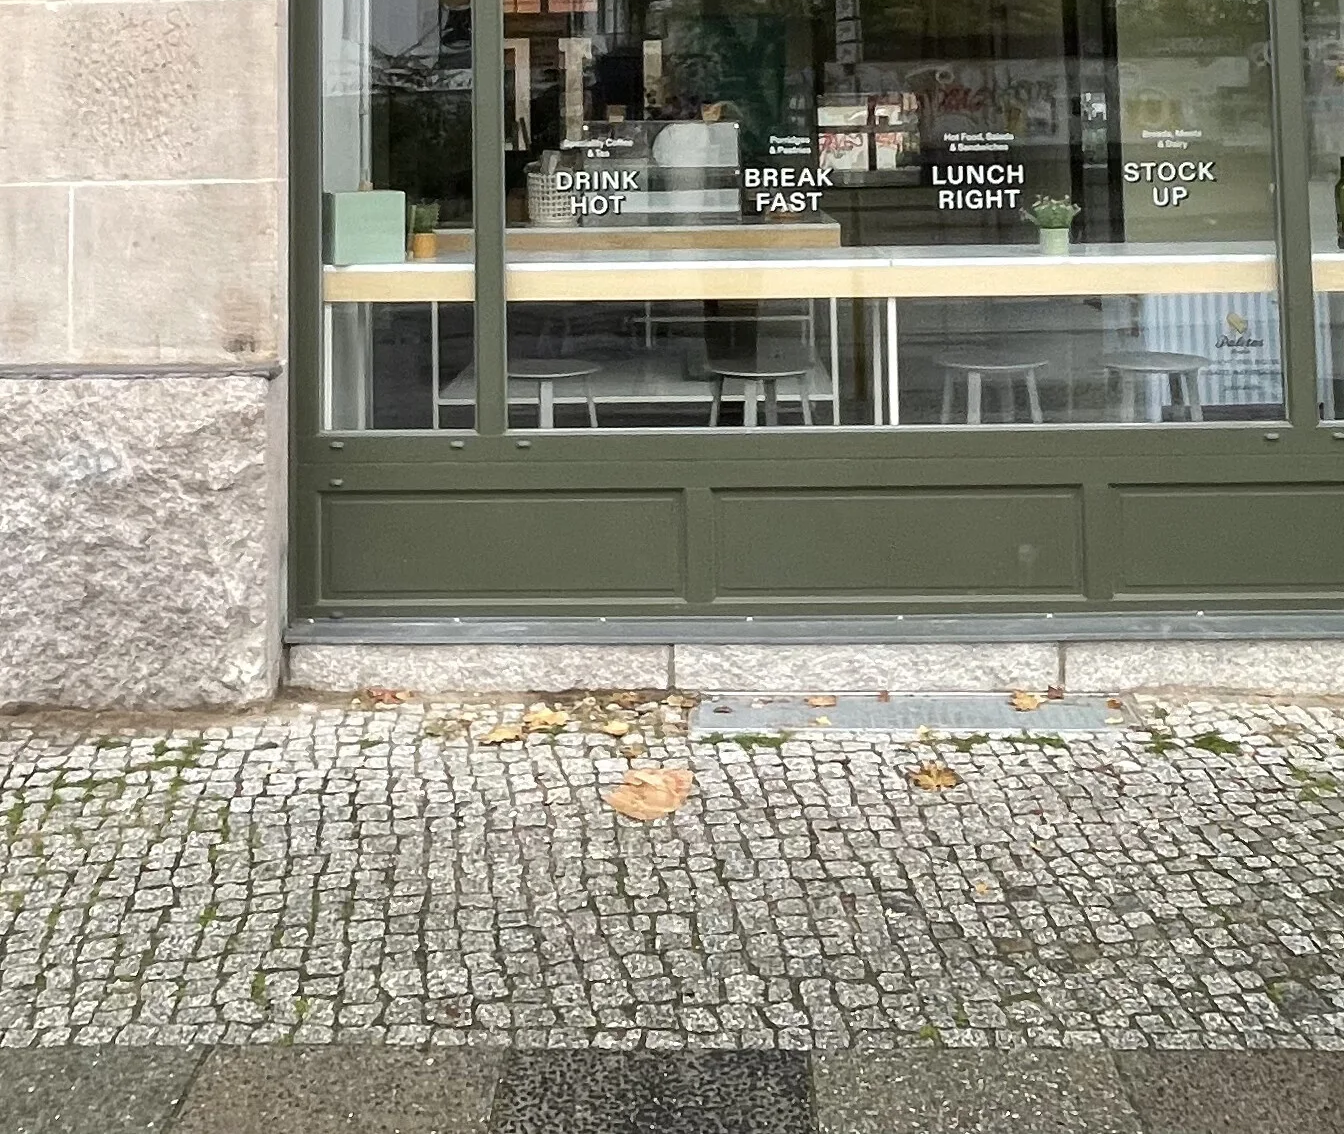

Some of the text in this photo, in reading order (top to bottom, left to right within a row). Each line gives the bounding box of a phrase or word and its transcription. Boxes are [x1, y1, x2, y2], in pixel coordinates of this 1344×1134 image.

[605, 137, 634, 148] Coffee
[556, 171, 639, 191] DRINK
[744, 168, 833, 187] BREAK
[932, 164, 1025, 185] LUNCH
[1123, 162, 1215, 182] STOCK
[570, 195, 626, 215] HOT
[756, 192, 823, 212] FAST
[938, 189, 1021, 210] RIGHT
[1152, 187, 1188, 207] UP
